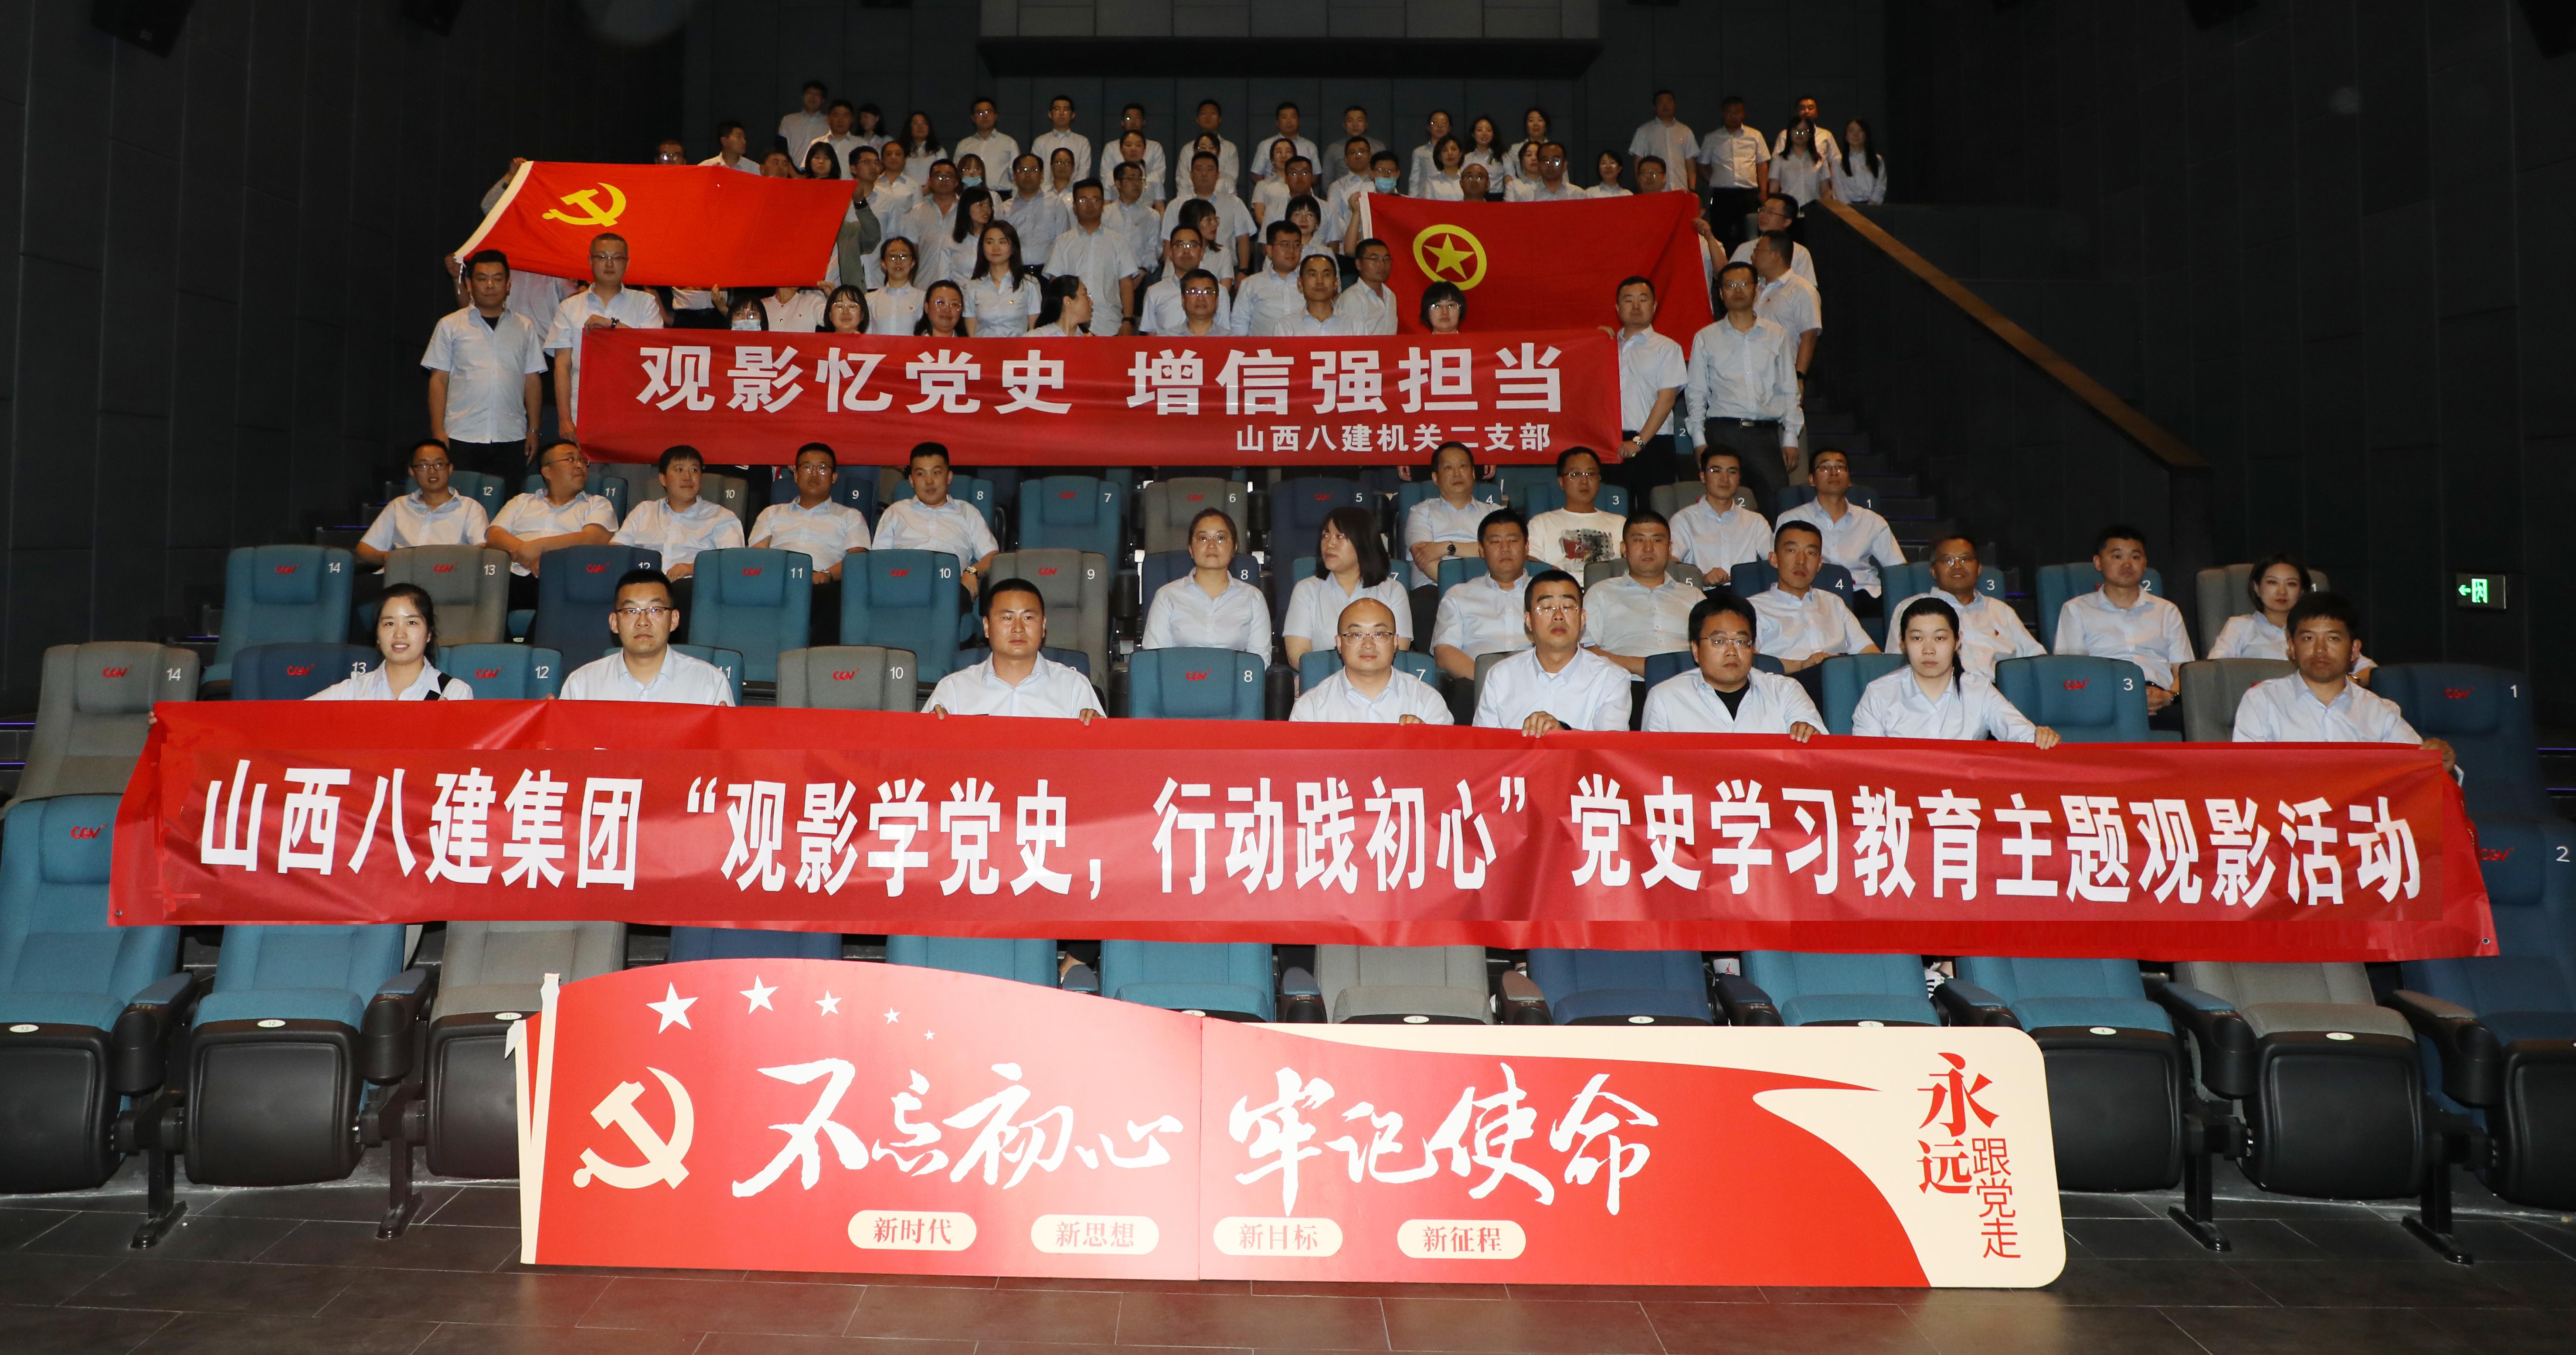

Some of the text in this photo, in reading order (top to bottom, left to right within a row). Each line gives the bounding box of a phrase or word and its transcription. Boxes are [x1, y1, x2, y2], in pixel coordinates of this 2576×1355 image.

[636, 343, 1561, 415] 观影忆党史 增信强担当
[1237, 422, 1550, 452] 山西八建机关二支部
[1679, 428, 1686, 436] 2
[483, 487, 493, 496] 12
[605, 487, 615, 497] 11
[726, 490, 735, 499] 10
[852, 490, 859, 499] 9
[977, 491, 984, 500] 8
[1104, 493, 1112, 503] 7
[1229, 494, 1237, 503] 6
[1356, 493, 1363, 502] 5
[1486, 495, 1493, 504] 4
[1613, 496, 1619, 505] 3
[1738, 497, 1746, 507] 2
[1867, 499, 1871, 508] 1
[275, 565, 296, 574] CGV
[329, 562, 340, 573] 14
[484, 565, 496, 575] 13
[586, 564, 607, 573] CGV
[742, 567, 762, 576] CGV
[1039, 567, 1058, 576] CGV
[791, 568, 802, 579] 11
[939, 568, 951, 579] 10
[1087, 569, 1095, 580] 9
[1240, 569, 1248, 580] 8
[1686, 578, 1693, 587] 5
[1835, 579, 1844, 590] 4
[1987, 579, 1995, 590] 3
[2142, 580, 2151, 591] 2
[2311, 583, 2316, 592] 1
[102, 667, 127, 678] CGV
[286, 666, 311, 676] CGV
[352, 662, 367, 675] 13
[475, 669, 499, 679] CGV
[535, 666, 549, 679] 12
[890, 667, 904, 679] 10
[167, 668, 181, 681] 14
[832, 671, 856, 681] CGV
[1185, 671, 1209, 681] CGV
[1244, 670, 1253, 682] 8
[1416, 669, 1426, 681] 7
[2064, 680, 2087, 690] CGV
[2123, 678, 2133, 691] 3
[2444, 688, 2470, 698] CGV
[2511, 685, 2517, 698] 1
[70, 824, 99, 838] CGV
[2480, 849, 2509, 861] CGV
[2556, 846, 2570, 862] 2
[1917, 1052, 2000, 1195] 永远
[733, 1058, 1660, 1216] 不忘初心 牢记使命
[1971, 1138, 2021, 1258] 跟党走
[873, 1217, 952, 1245] 新时代
[1055, 1221, 1135, 1247] 新思想
[1239, 1223, 1318, 1251] 新目标
[1423, 1226, 1502, 1253] 新征程
